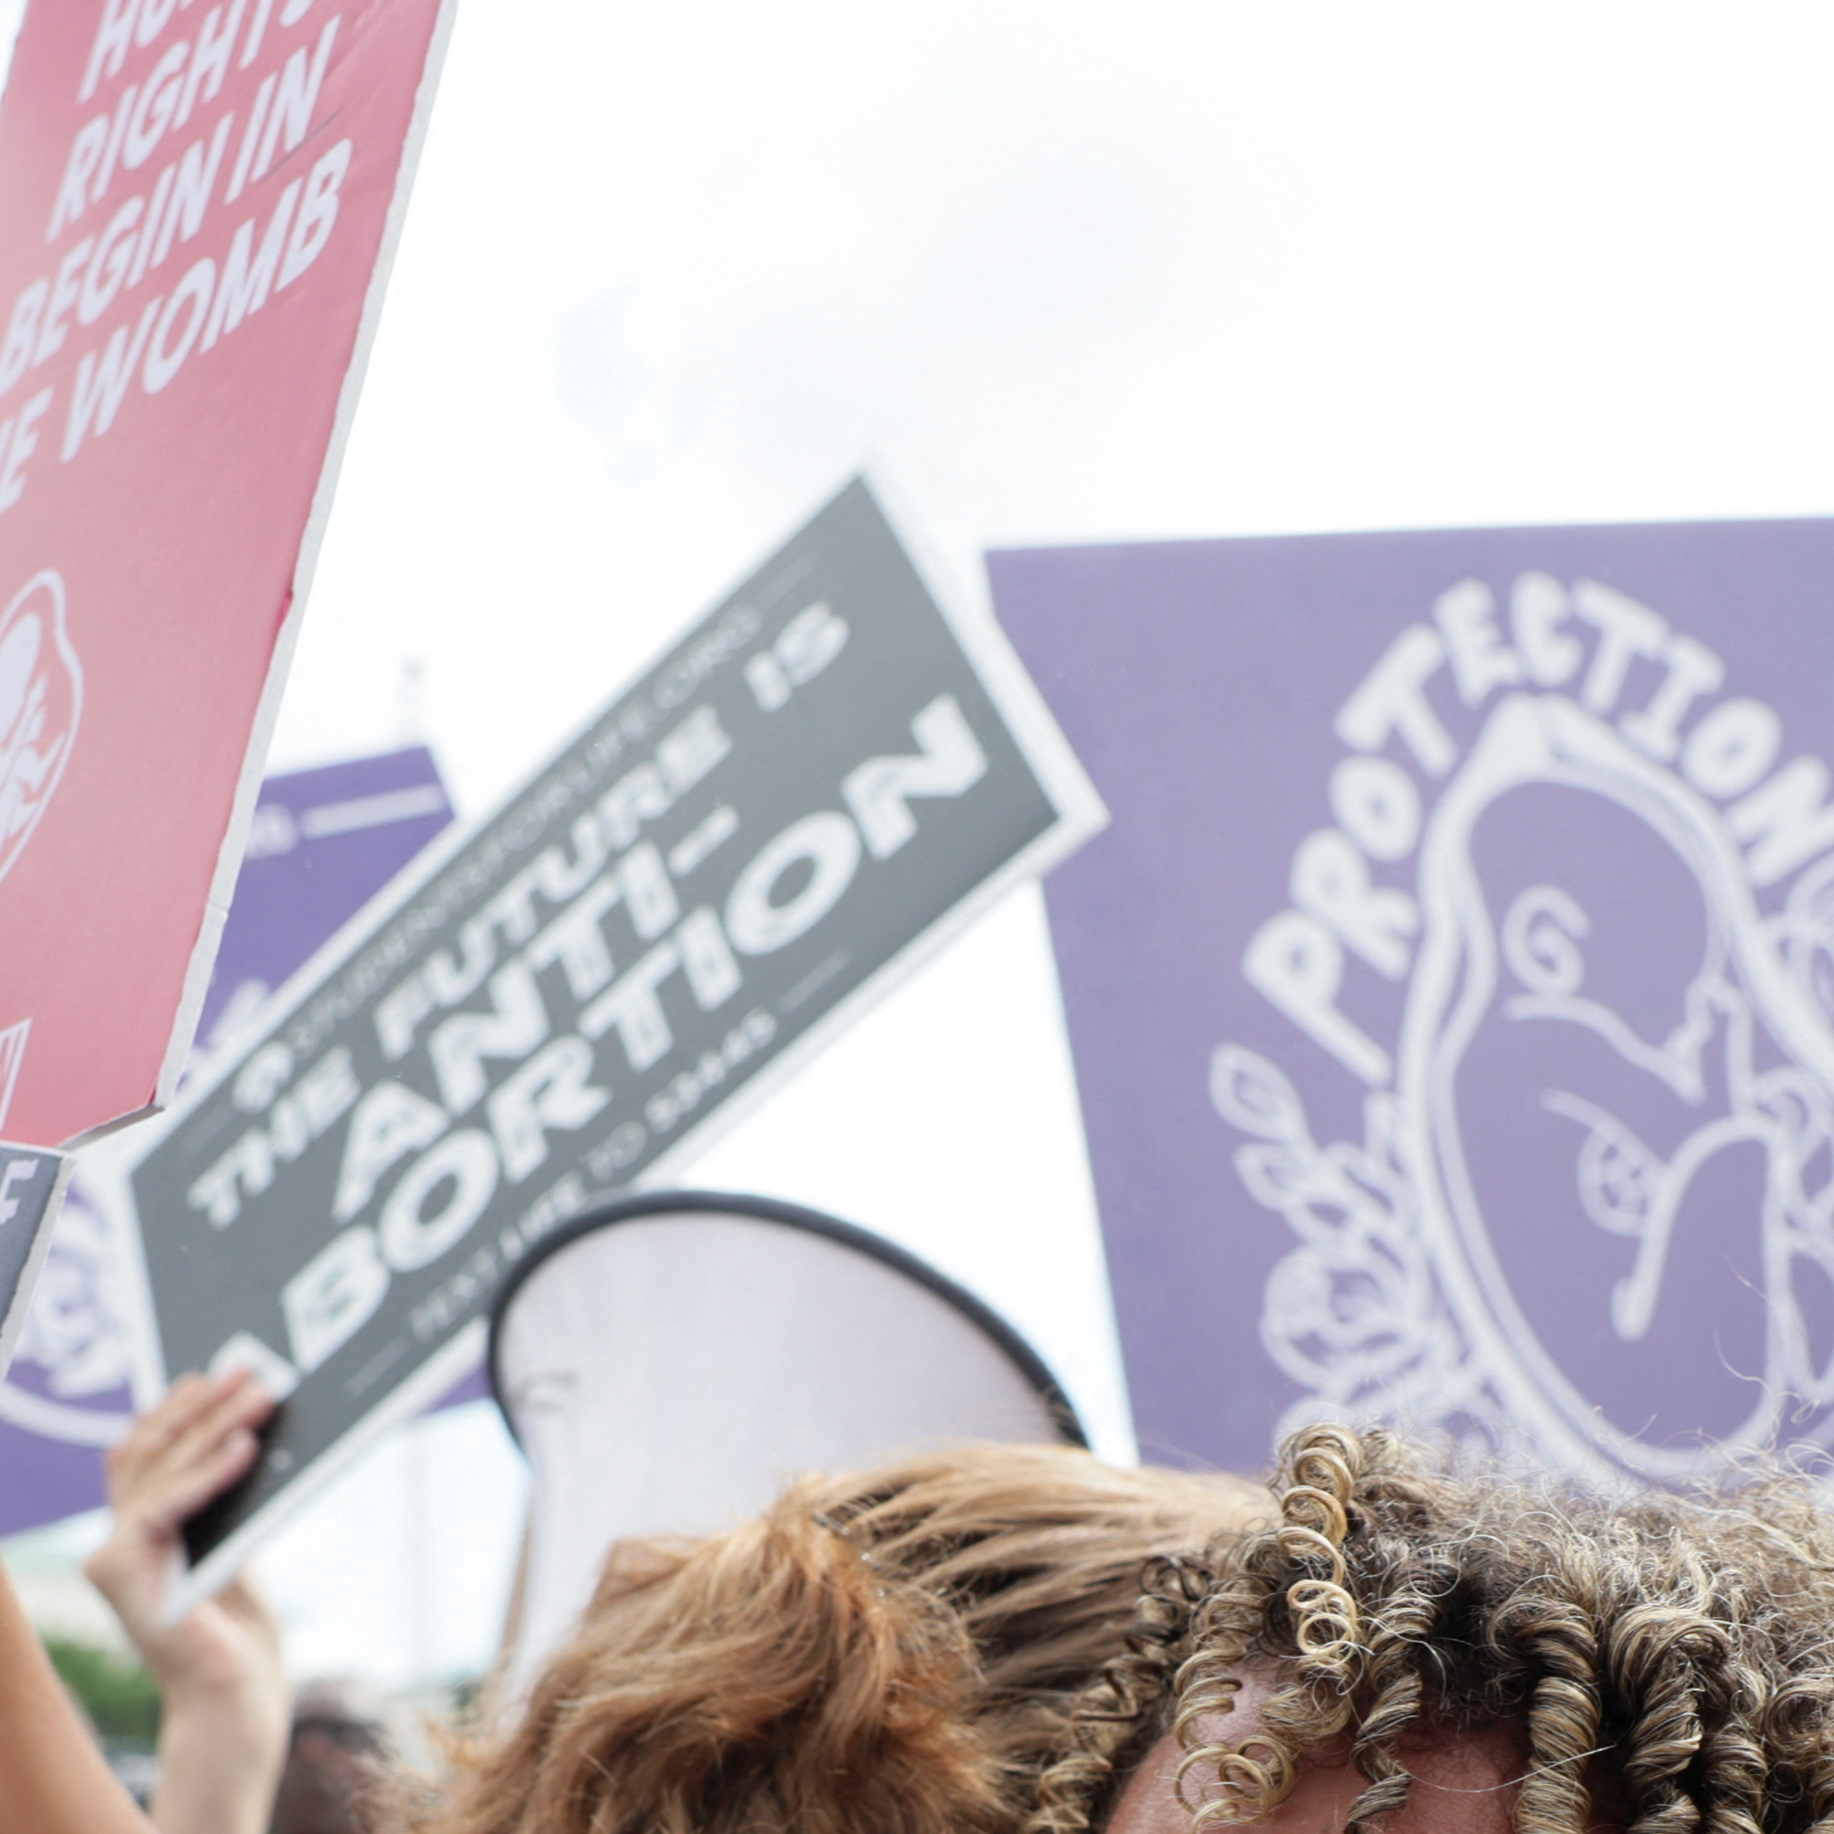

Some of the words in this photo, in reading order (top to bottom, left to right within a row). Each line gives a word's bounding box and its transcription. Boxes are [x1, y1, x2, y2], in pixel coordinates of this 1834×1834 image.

[223, 12, 342, 207] IN
[60, 138, 354, 466] WOMB
[185, 1043, 363, 1231] THE
[372, 702, 736, 1065] FUTURE
[742, 600, 851, 715] IS
[331, 802, 741, 1224] ANTI-
